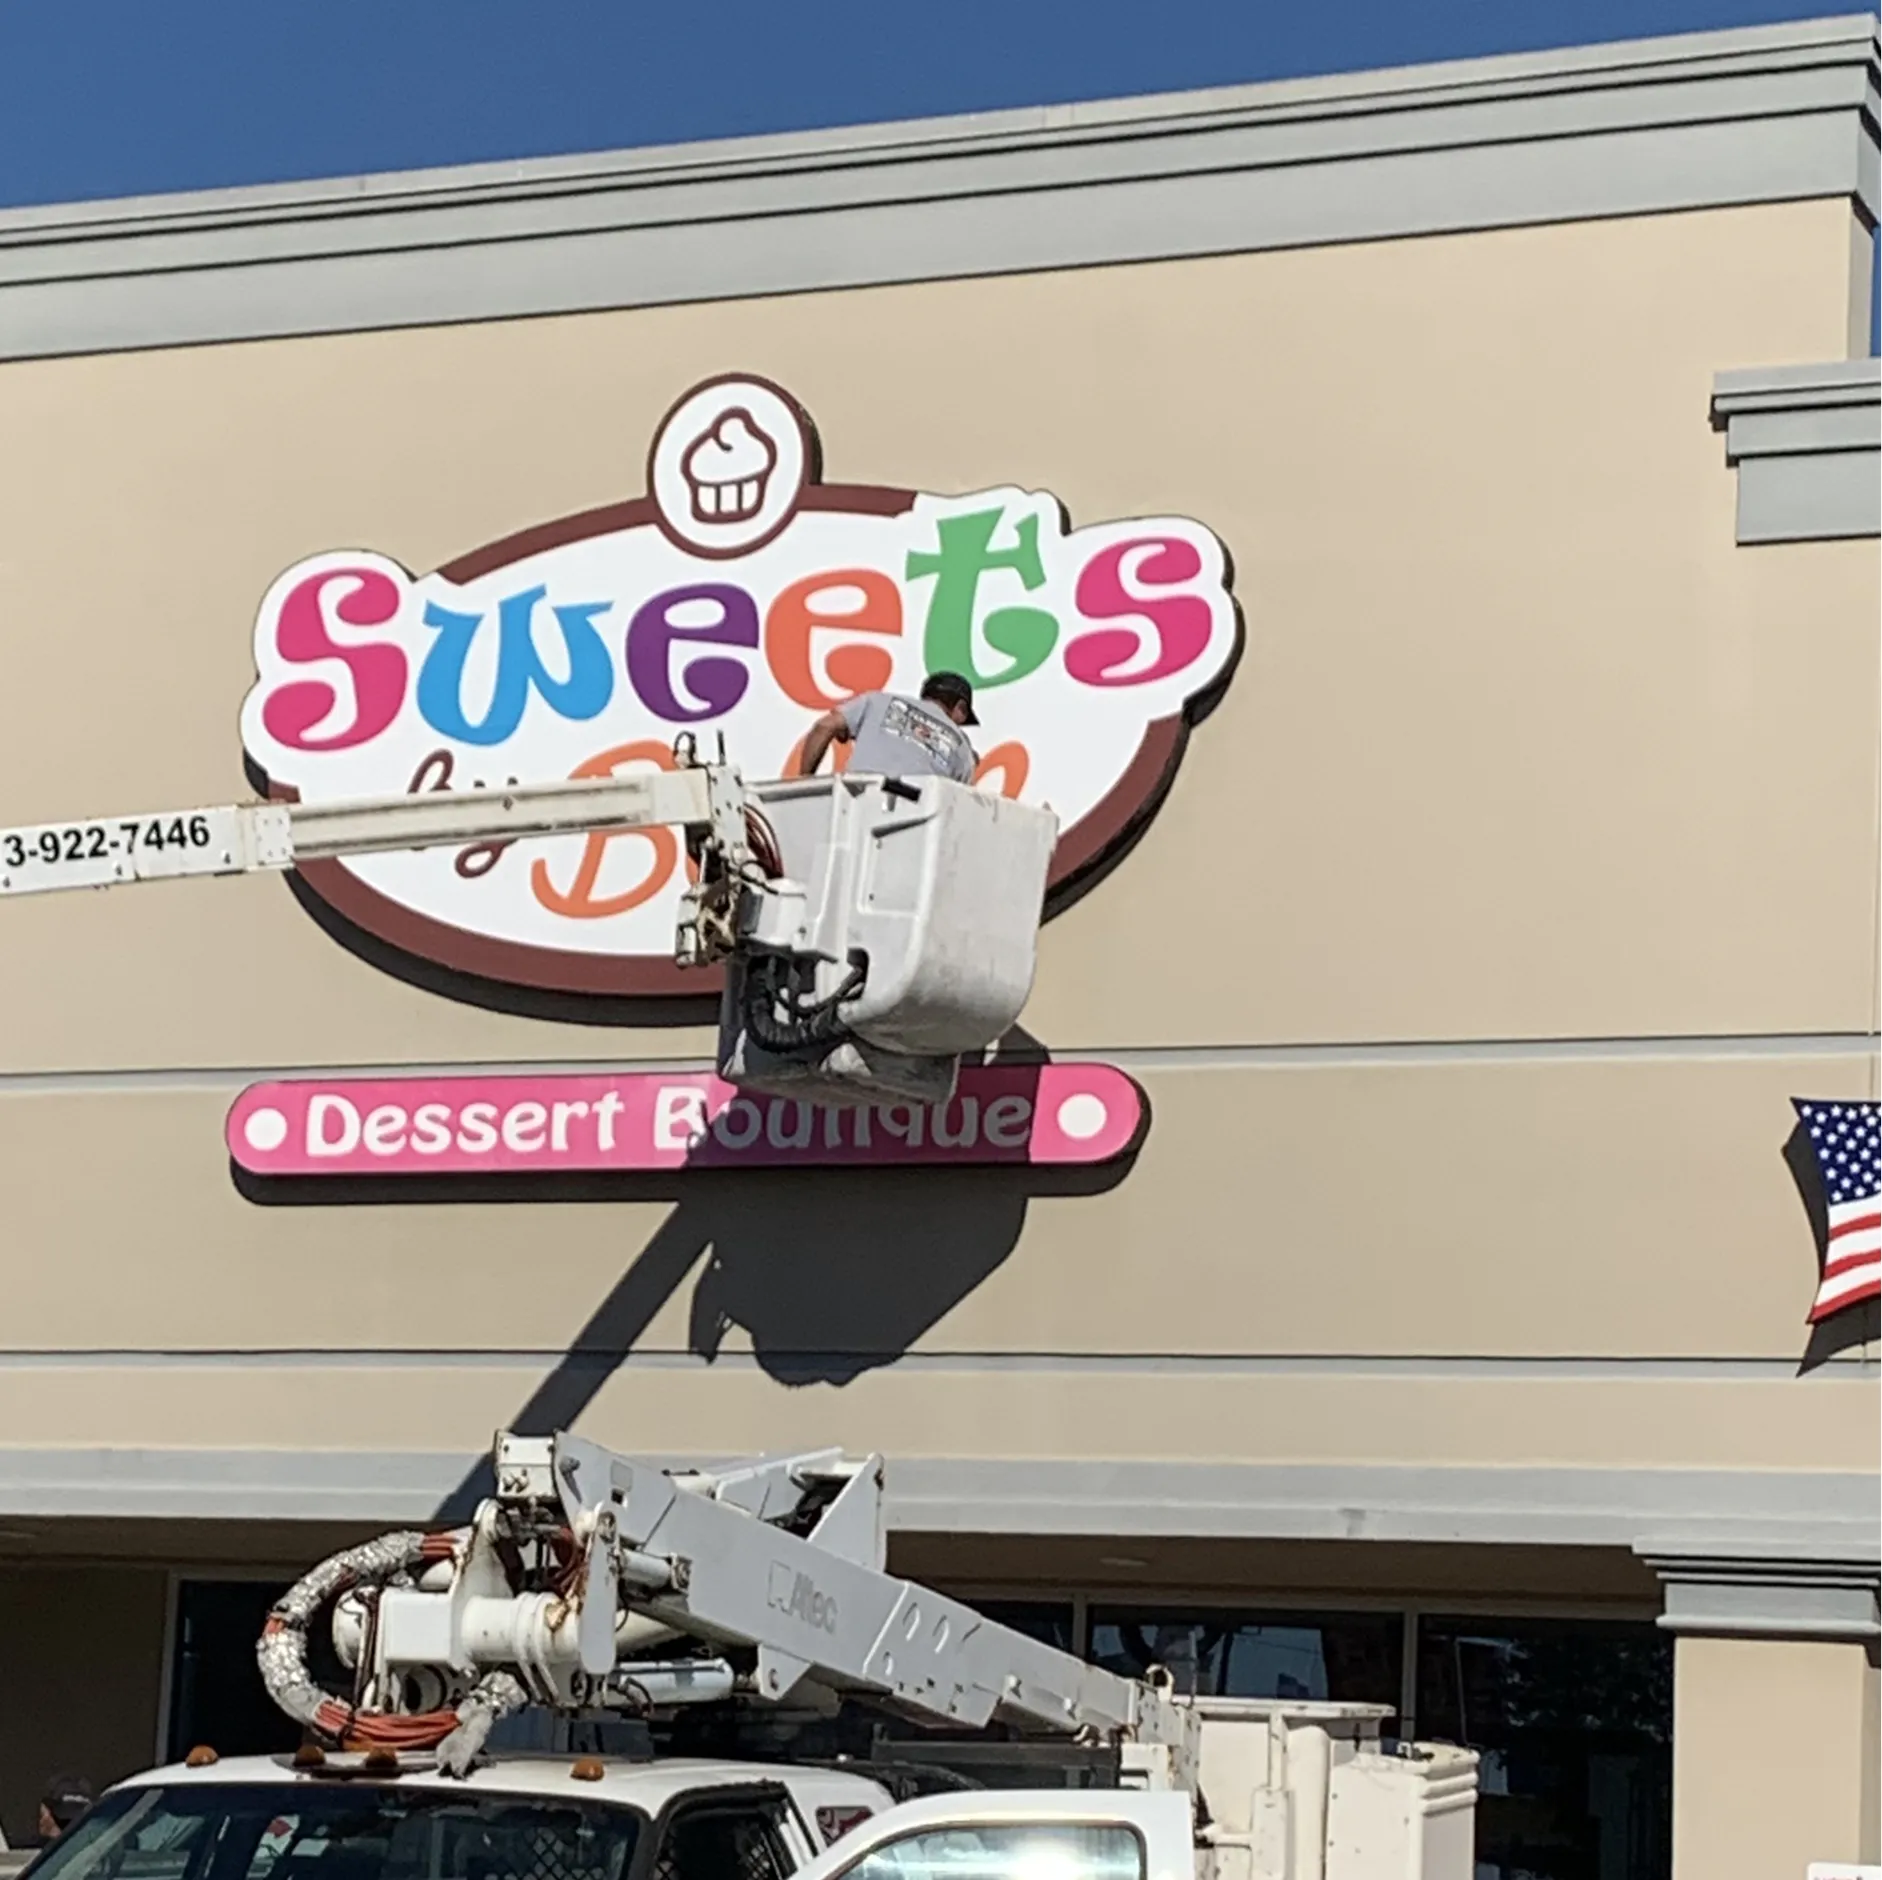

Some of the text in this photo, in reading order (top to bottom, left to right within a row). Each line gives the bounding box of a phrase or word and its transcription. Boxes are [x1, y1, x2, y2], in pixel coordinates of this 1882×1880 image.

[262, 506, 1213, 752] Sweets
[3, 816, 211, 868] 3-922-7446
[305, 1085, 1031, 1158] Dessert Boutique
